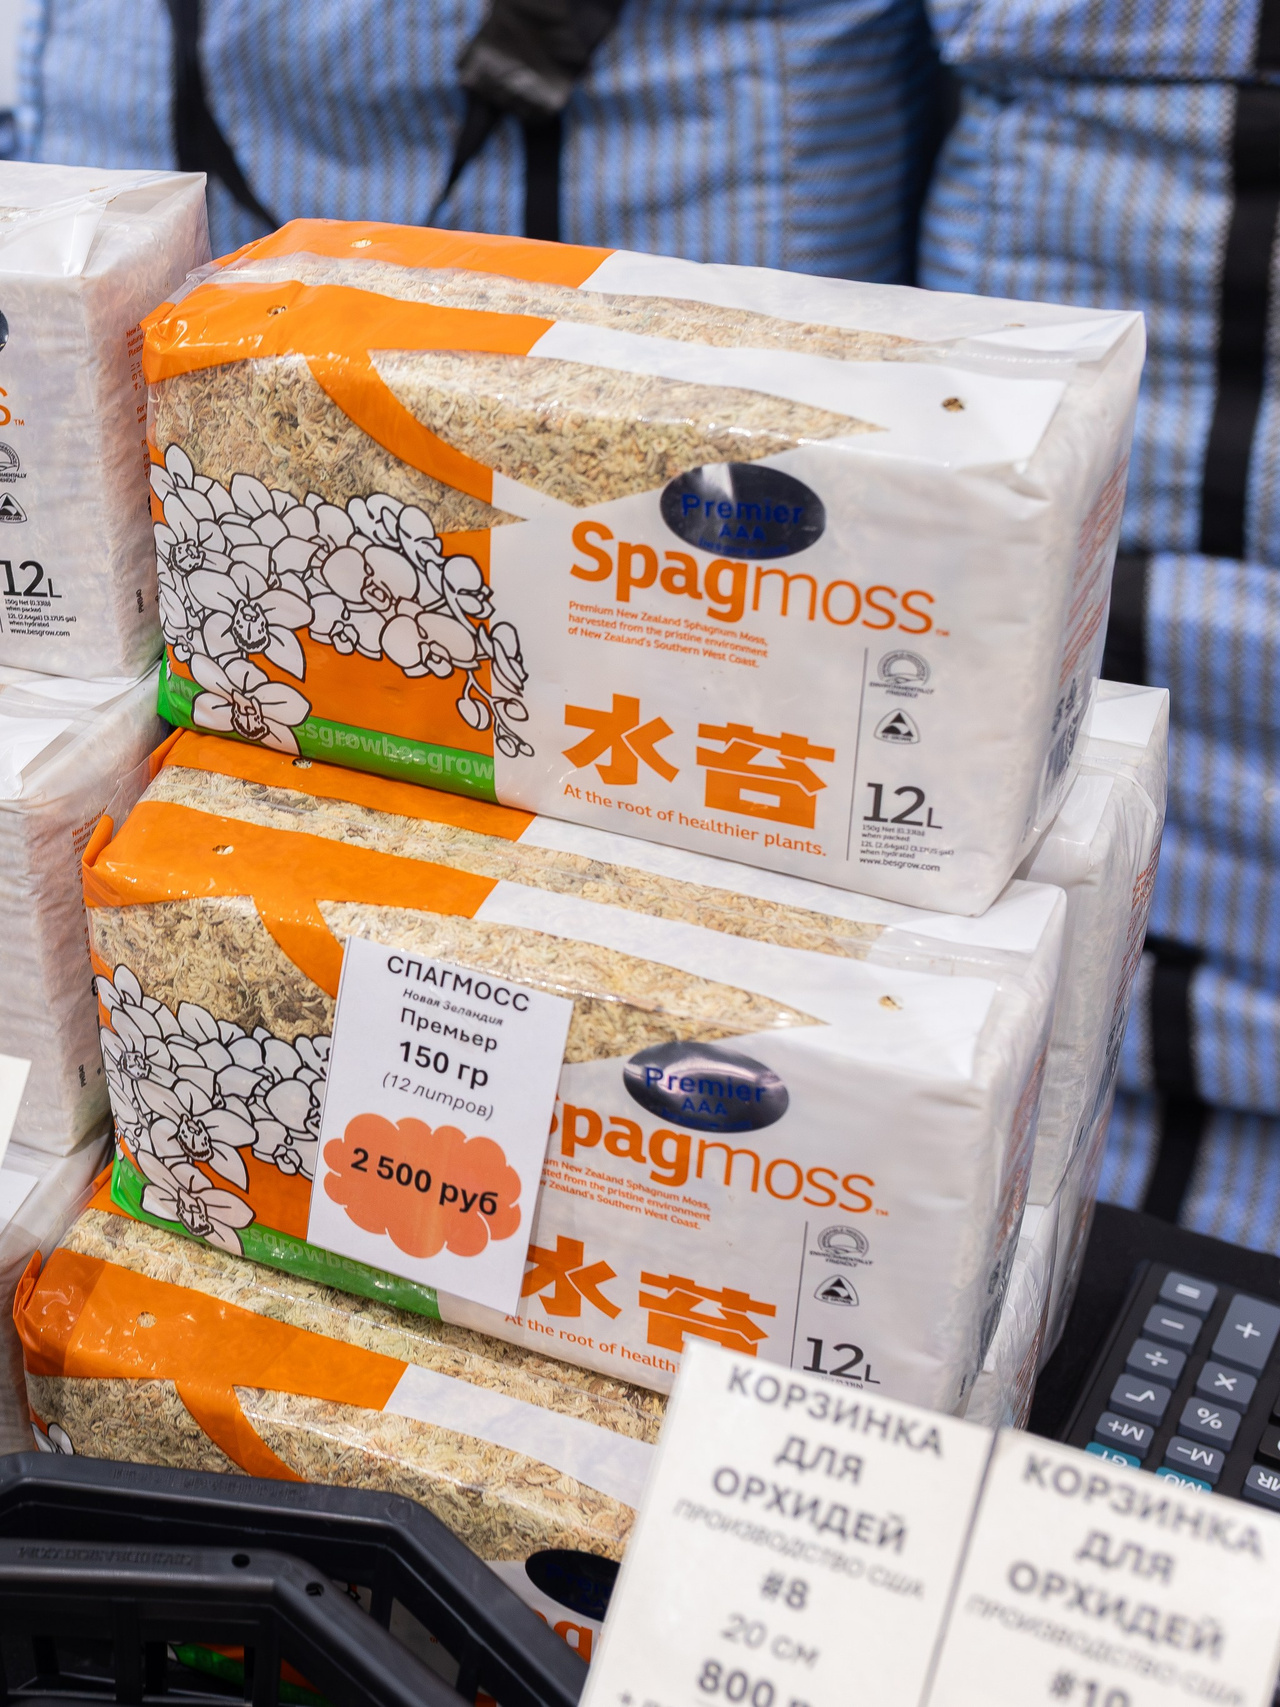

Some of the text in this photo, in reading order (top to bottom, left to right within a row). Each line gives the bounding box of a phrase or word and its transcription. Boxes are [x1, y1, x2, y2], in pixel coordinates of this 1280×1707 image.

[682, 493, 804, 524] Premier
[719, 525, 766, 540] AAA
[10, 628, 70, 636] www.besgrow.com
[561, 693, 836, 829] 水苔
[563, 783, 825, 856] At the root of healthier plants.
[862, 782, 943, 830] 12L
[387, 955, 530, 1013] СПАГМОСС
[402, 988, 502, 1025] Новая Зеландия
[400, 1008, 498, 1052] Премьер
[399, 1041, 489, 1089] 150 гр
[645, 1067, 767, 1103] Premier
[382, 1072, 494, 1121] (12 литров)
[681, 1099, 728, 1116] AAA
[351, 1148, 499, 1216] 2 500 руб
[527, 1318, 618, 1355] the root of
[803, 1336, 881, 1384] 12L
[726, 1365, 944, 1459] КОРЗИНКА
[775, 1436, 866, 1485] ДЛЯ
[713, 1467, 908, 1556] ОРХИДЕЙ
[1023, 1453, 1263, 1562] КОРЗИНКА
[1075, 1528, 1176, 1585] ДЛЯ
[760, 1569, 810, 1611] #8
[1007, 1559, 1226, 1660] ОРХИДЕЙ
[722, 1613, 820, 1668] 20 см
[697, 1660, 775, 1707] 800
